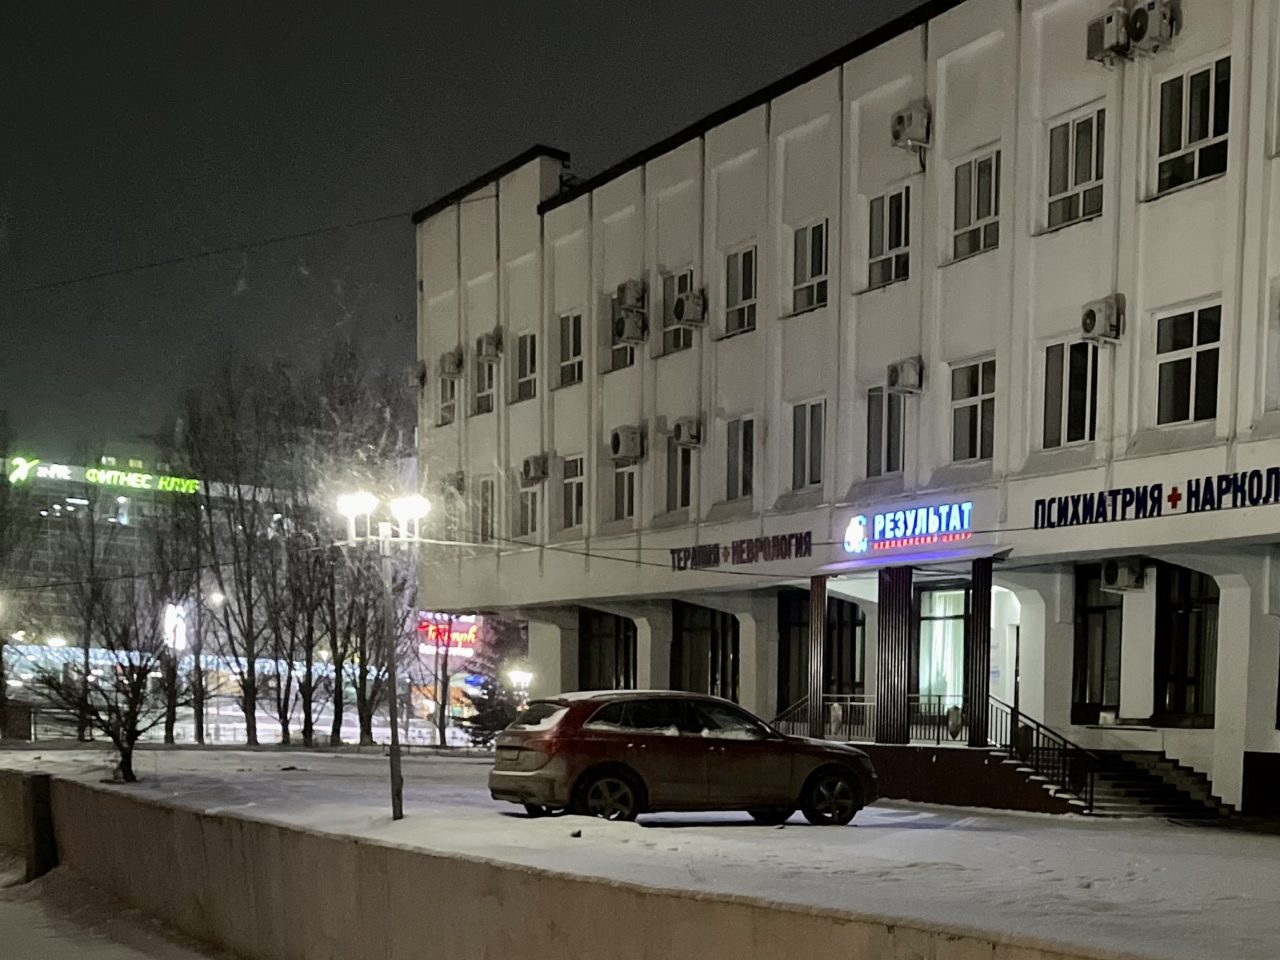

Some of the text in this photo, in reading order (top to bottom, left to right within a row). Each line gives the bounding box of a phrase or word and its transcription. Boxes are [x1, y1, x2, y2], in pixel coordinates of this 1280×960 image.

[85, 467, 201, 494] ФИТНЕС КЛУБ
[873, 501, 973, 540] РЕЗУЛЬТАТ
[1033, 483, 1163, 529] ПСИХИАТРИЯ
[731, 531, 813, 565] НЕВРОЛОГИЯ
